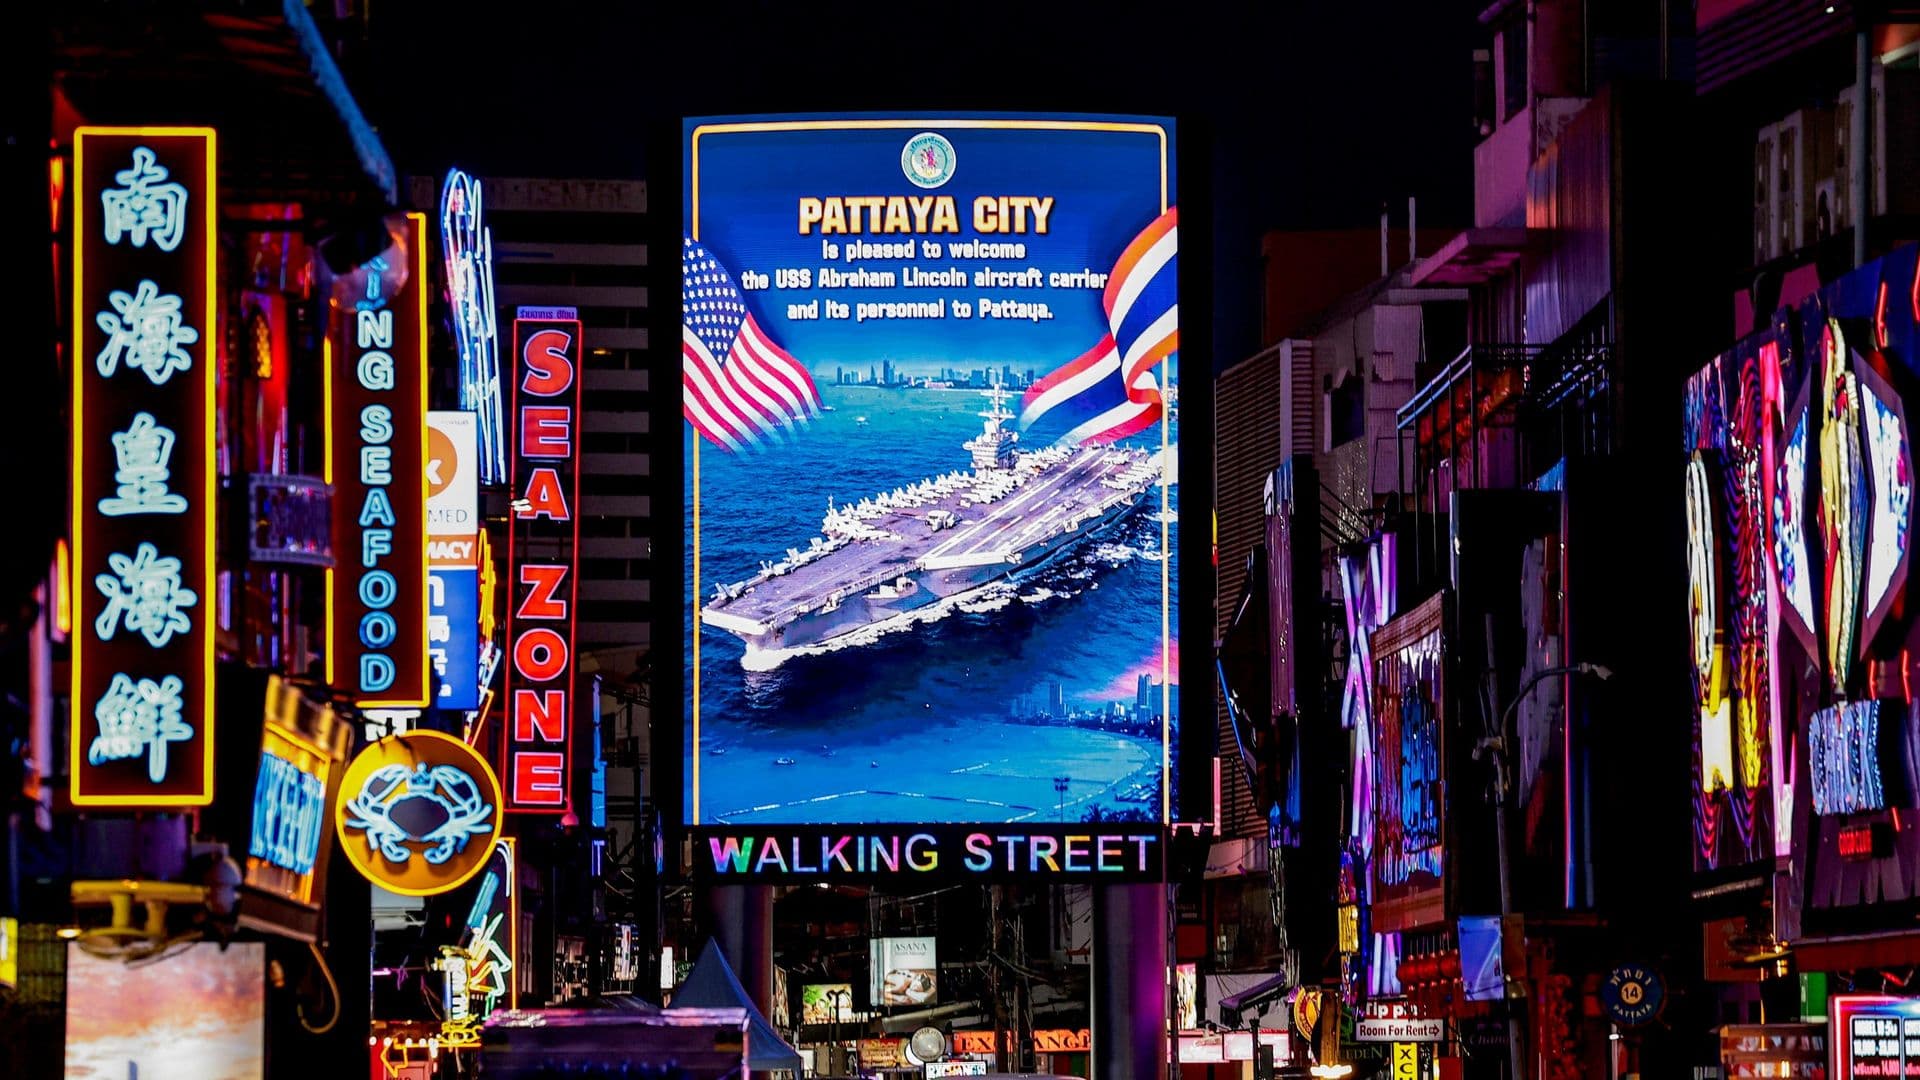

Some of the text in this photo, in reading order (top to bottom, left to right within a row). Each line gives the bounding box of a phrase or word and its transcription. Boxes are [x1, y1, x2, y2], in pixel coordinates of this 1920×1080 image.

[798, 196, 1054, 235] PATTAYA CITY
[822, 239, 1026, 263] is pleased to welcome
[741, 267, 1108, 290] the USS Abraham Lincoln aircraft carrier
[787, 298, 1053, 322] and its personnel to Pattaya.
[356, 256, 395, 392] ING
[358, 404, 397, 692] SEAFOOD
[513, 329, 574, 805] SEA ZONE
[709, 833, 1157, 873] WALKING STREET
[895, 942, 928, 952] ASANA
[1624, 986, 1639, 1000] 14
[1613, 1004, 1653, 1018] PATTAYA
[1360, 1025, 1428, 1036] Room For Rent
[961, 1035, 1090, 1051] EXANG
